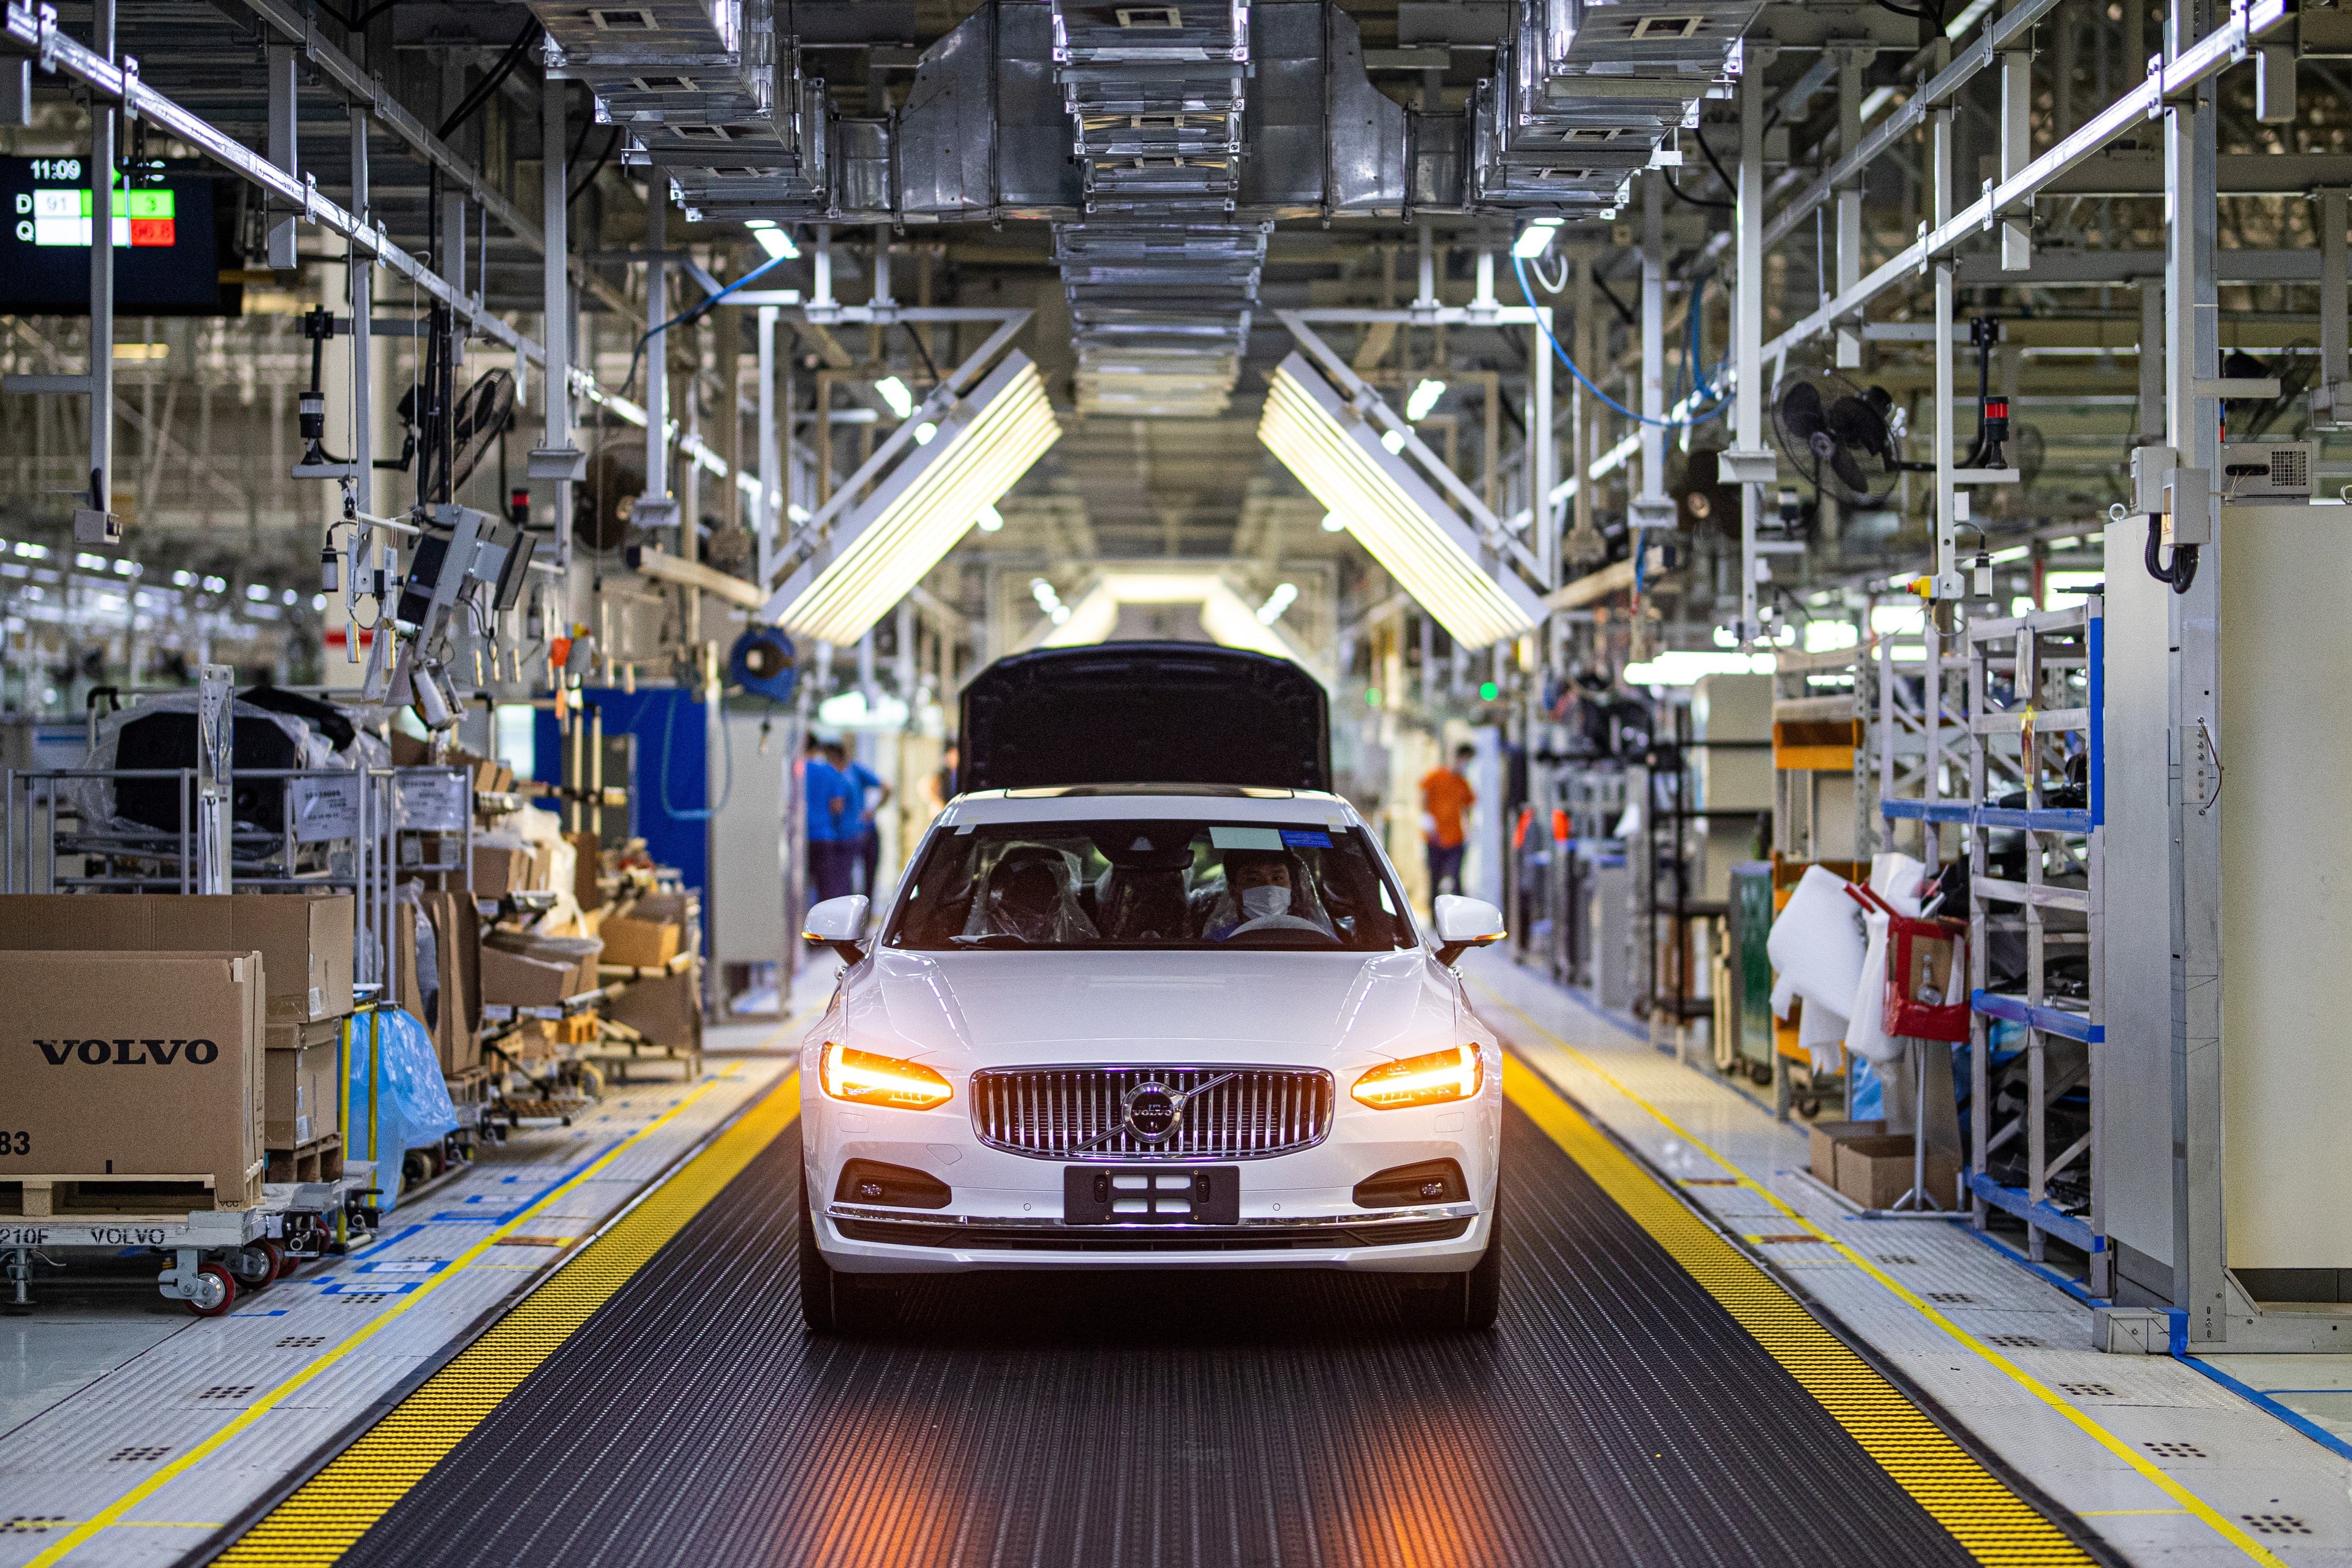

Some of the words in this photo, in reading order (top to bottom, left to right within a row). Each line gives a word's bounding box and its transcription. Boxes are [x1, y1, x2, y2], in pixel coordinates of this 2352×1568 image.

[31, 159, 81, 180] 11:09
[16, 194, 32, 214] D
[47, 195, 66, 211] 91
[16, 221, 34, 241] Q
[32, 1039, 219, 1065] VOLVO
[0, 1131, 31, 1155] 83
[91, 1227, 165, 1245] VOLVO
